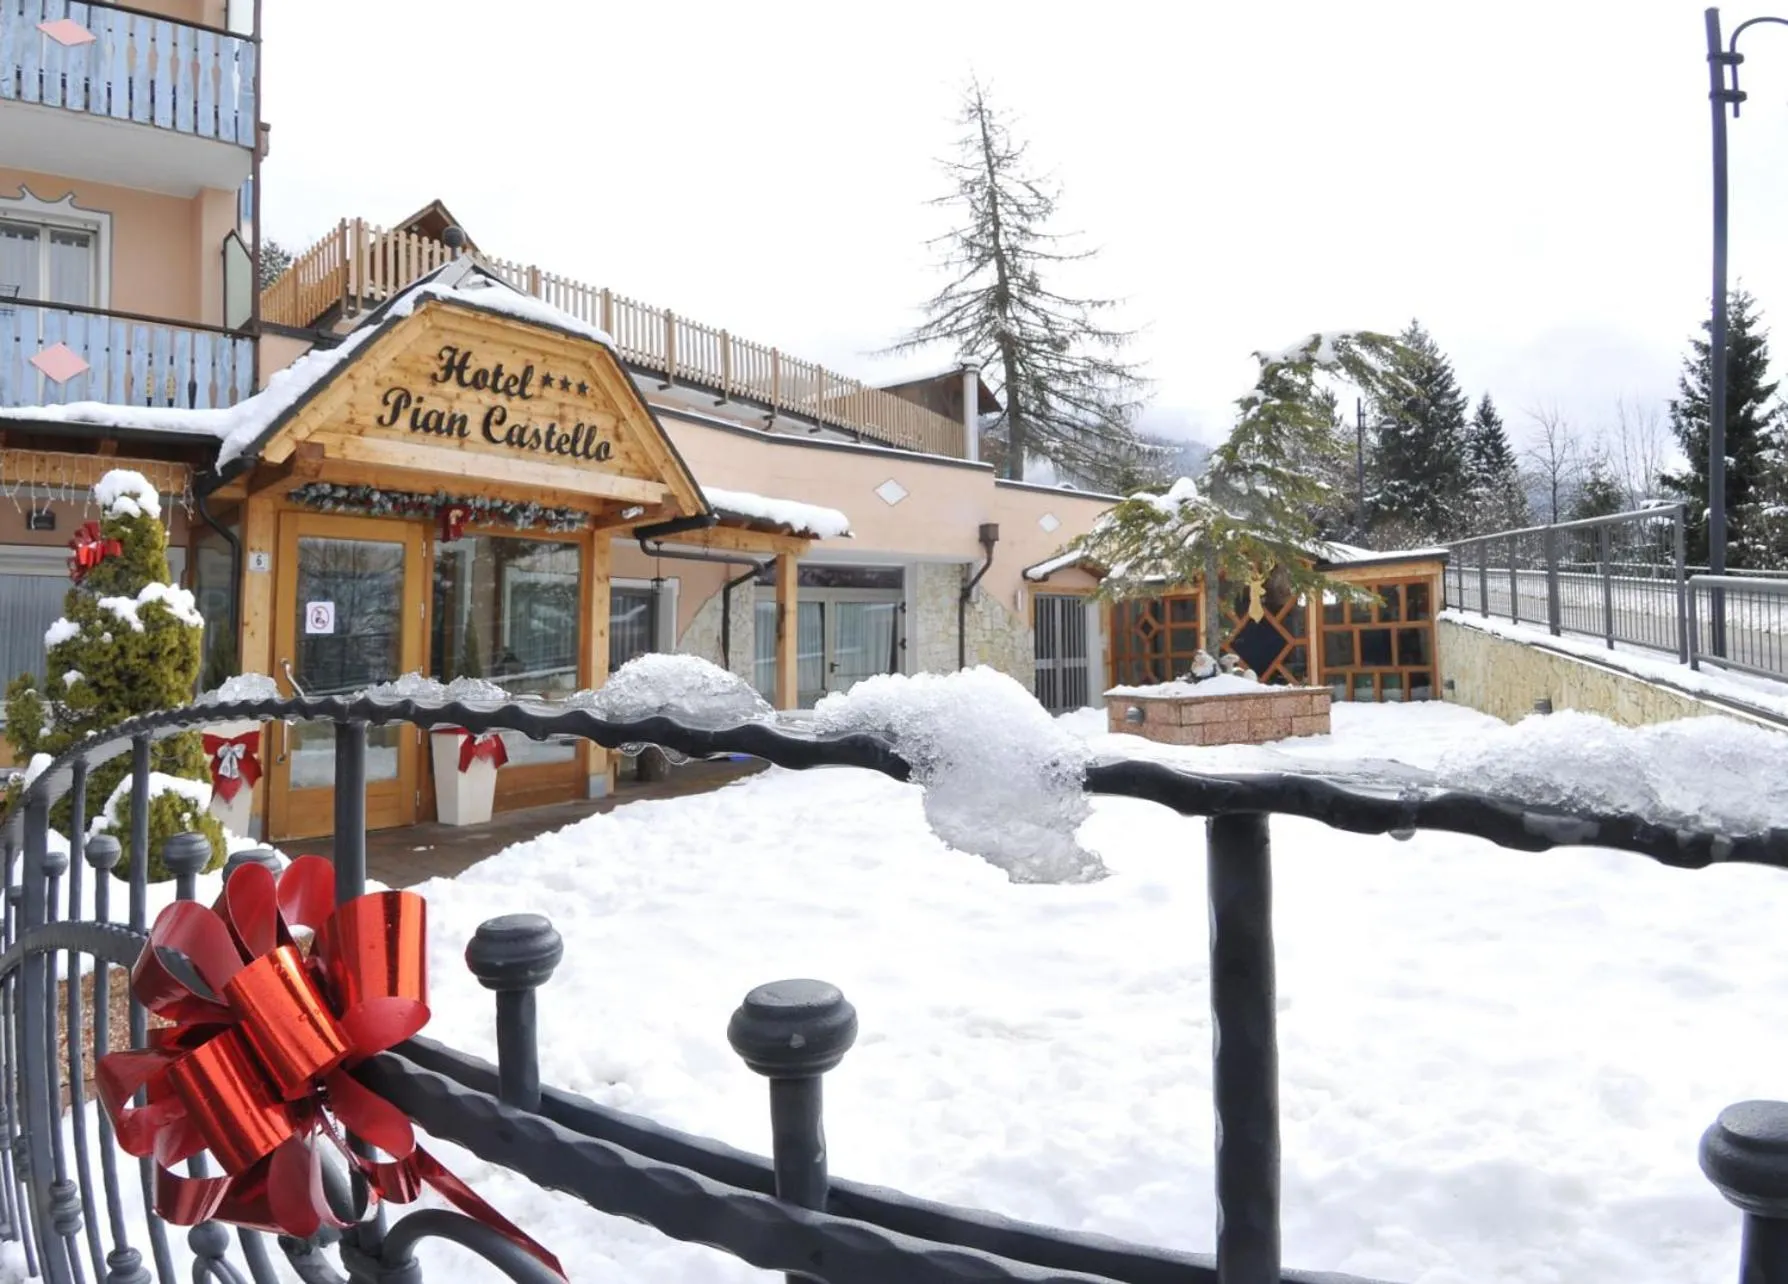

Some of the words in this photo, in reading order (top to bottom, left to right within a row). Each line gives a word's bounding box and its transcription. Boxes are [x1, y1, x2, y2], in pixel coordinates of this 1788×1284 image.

[431, 345, 535, 400] Hotel
[377, 386, 471, 439] Pian
[481, 404, 614, 462] Castello
[255, 553, 263, 567] 6
